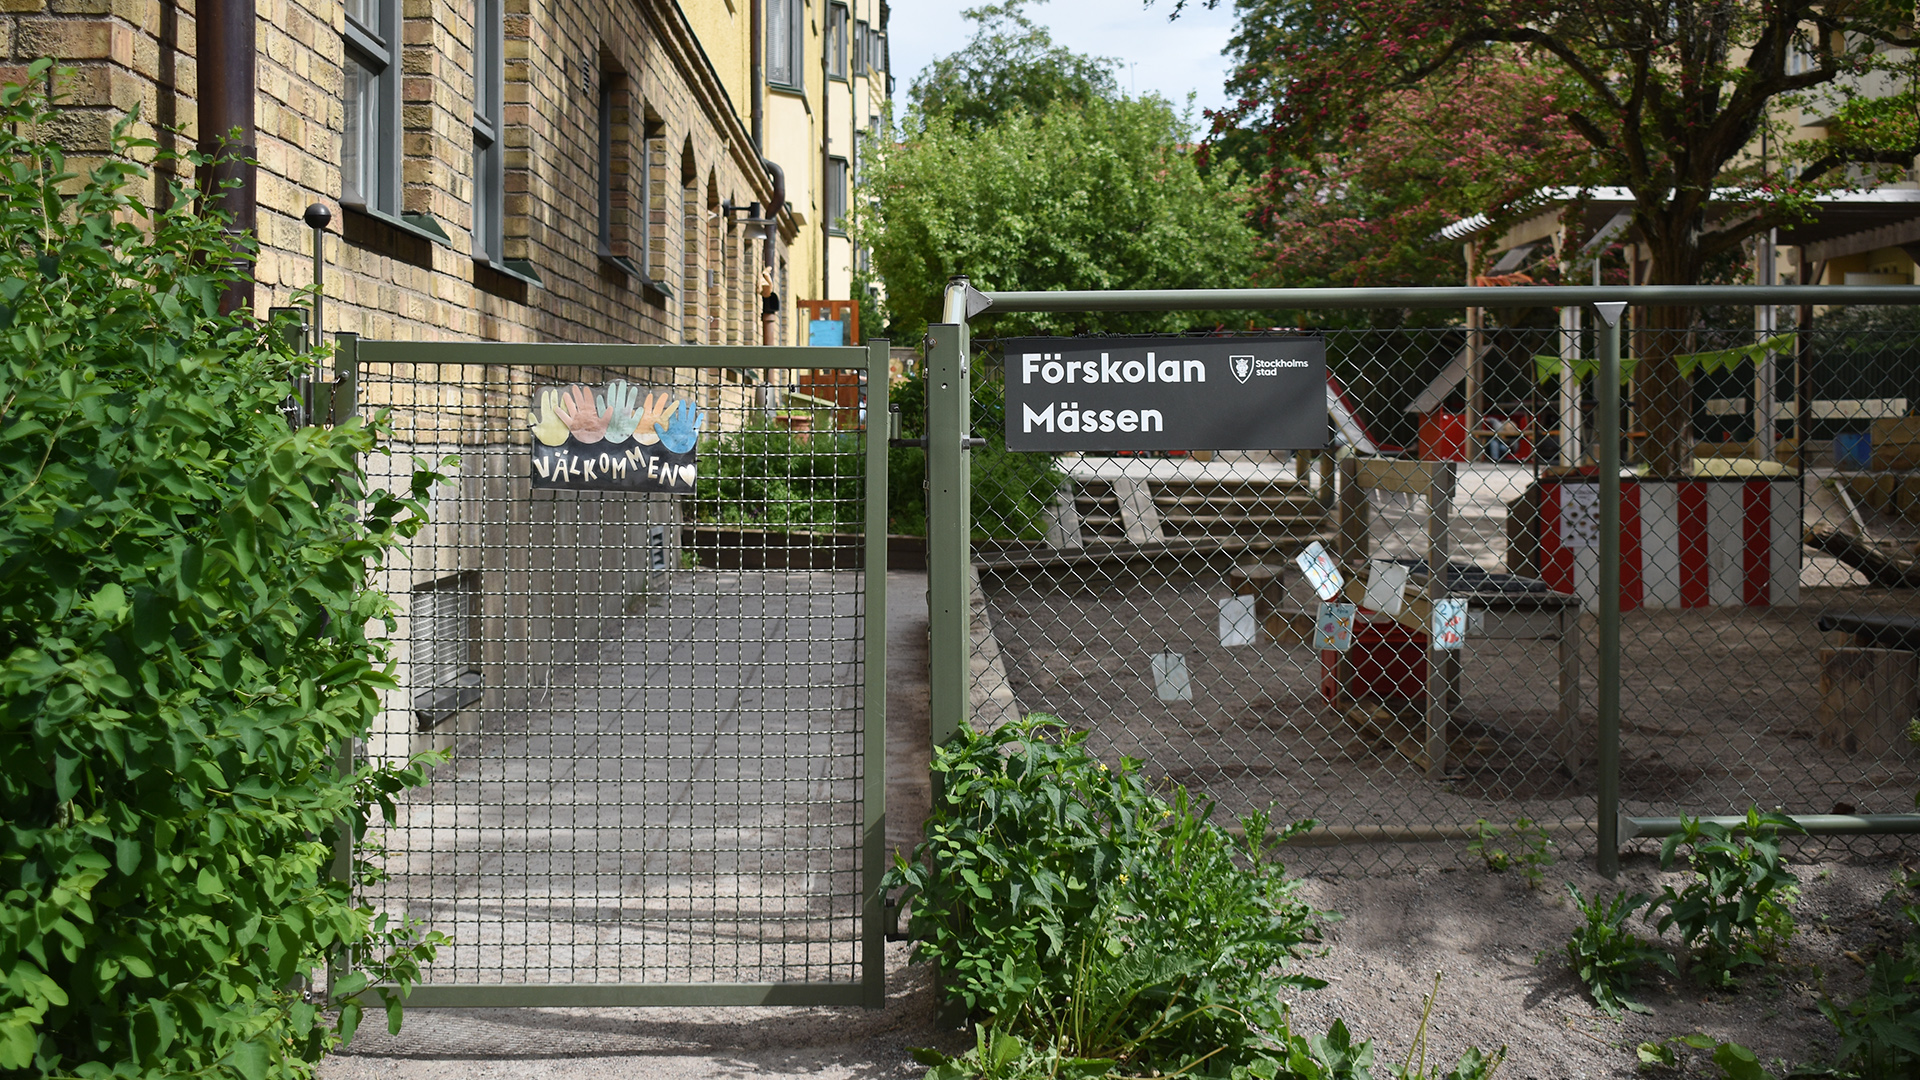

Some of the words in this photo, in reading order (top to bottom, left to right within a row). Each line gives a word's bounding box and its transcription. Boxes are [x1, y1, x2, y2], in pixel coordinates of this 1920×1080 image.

[1022, 352, 1206, 384] Förskolan
[1255, 359, 1309, 368] Stockholms
[1256, 367, 1277, 376] stad
[1022, 402, 1163, 433] Mässen
[533, 445, 679, 487] VÄLKOMMEN
